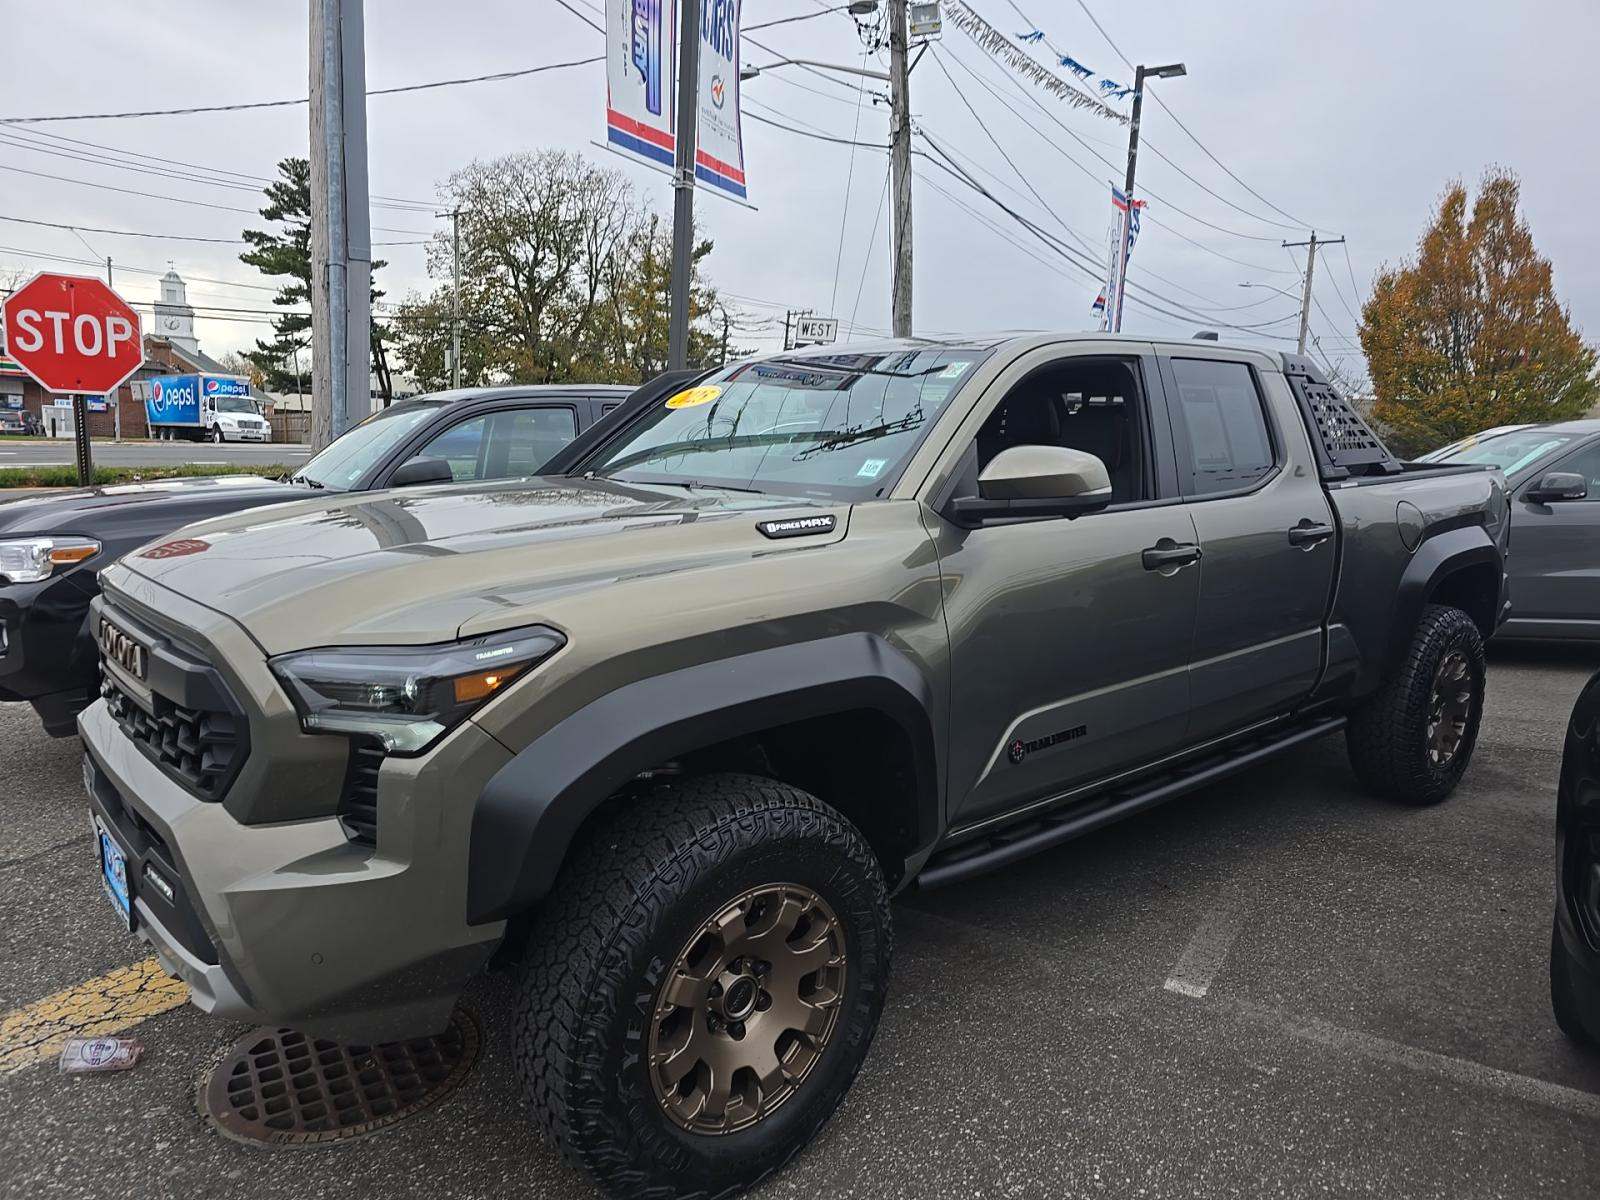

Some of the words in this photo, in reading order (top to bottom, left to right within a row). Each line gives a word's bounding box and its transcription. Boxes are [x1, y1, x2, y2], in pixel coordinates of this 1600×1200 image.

[15, 309, 133, 358] STOP
[802, 322, 832, 337] WEST
[165, 384, 196, 410] pepsi
[220, 384, 246, 394] pepsi
[101, 620, 142, 677] TOYOTA
